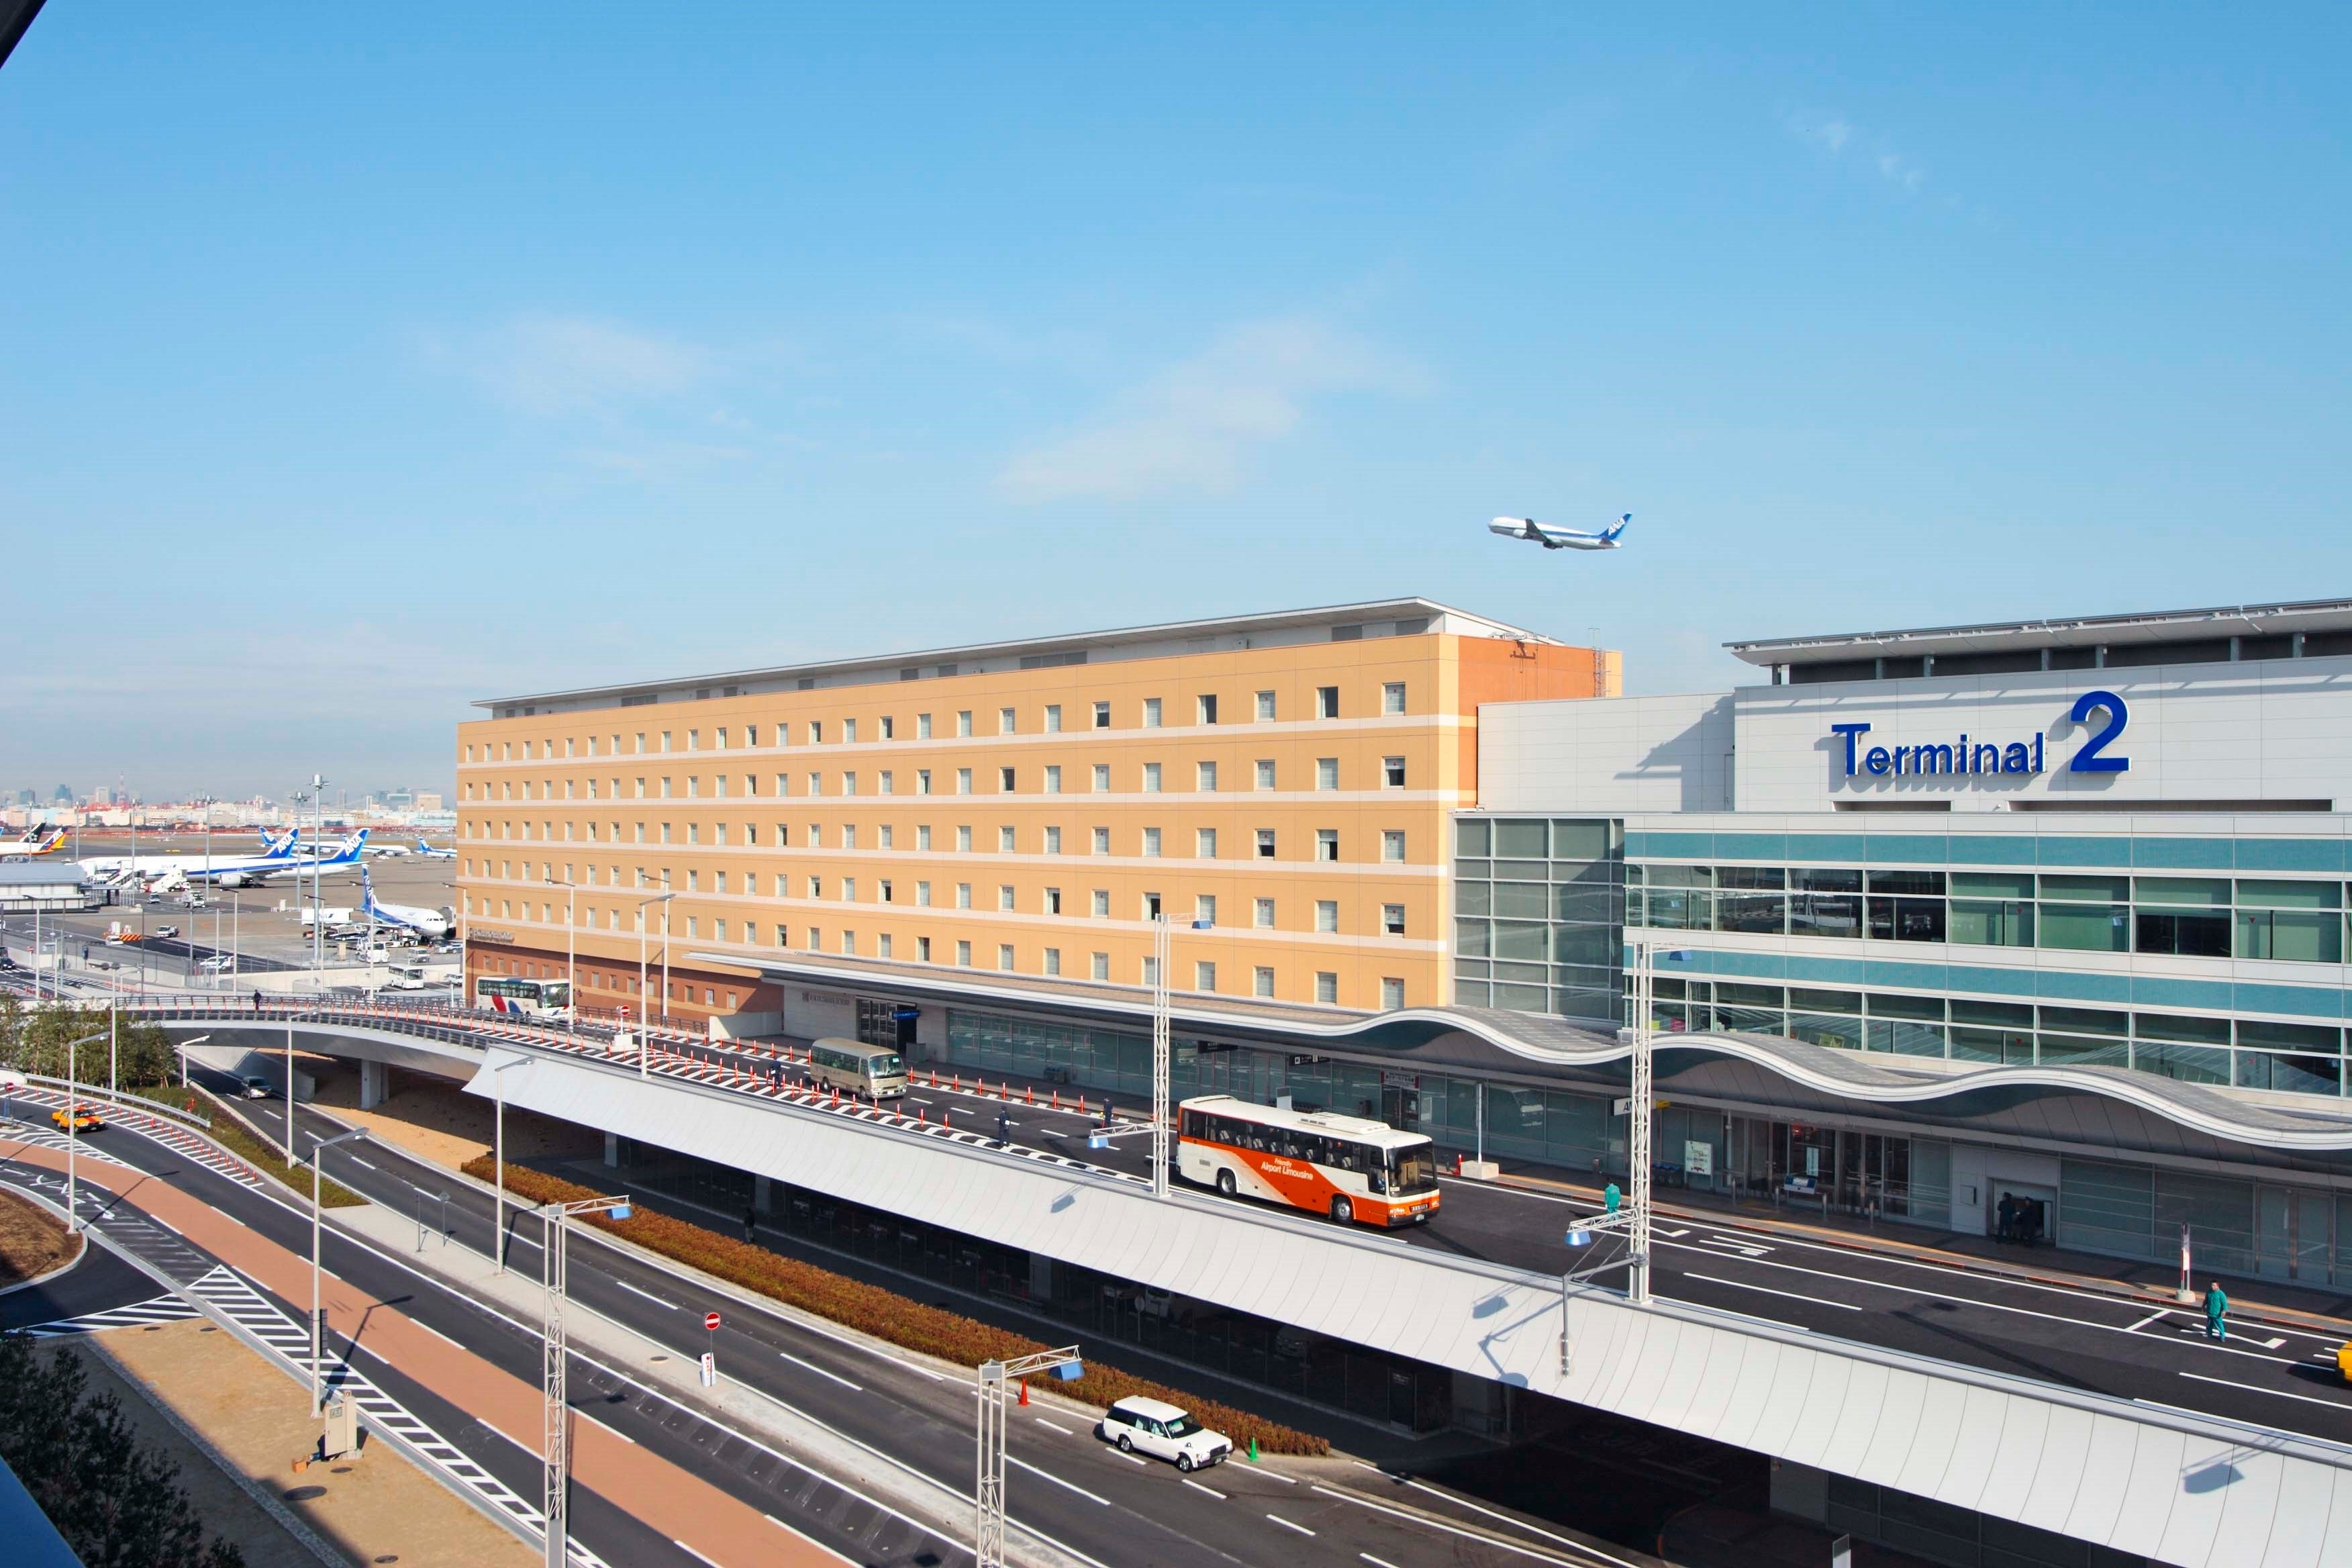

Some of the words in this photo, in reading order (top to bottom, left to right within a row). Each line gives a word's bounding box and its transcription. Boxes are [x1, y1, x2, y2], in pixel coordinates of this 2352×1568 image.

[1608, 518, 1625, 535] ANA
[1831, 722, 2047, 775] Terminal
[2069, 690, 2132, 772] 2
[277, 833, 295, 854] ANA
[344, 834, 363, 856] ANA
[1261, 1161, 1282, 1173] Airport
[1282, 1165, 1313, 1180] Limousine
[1275, 1158, 1291, 1168] Friendly
